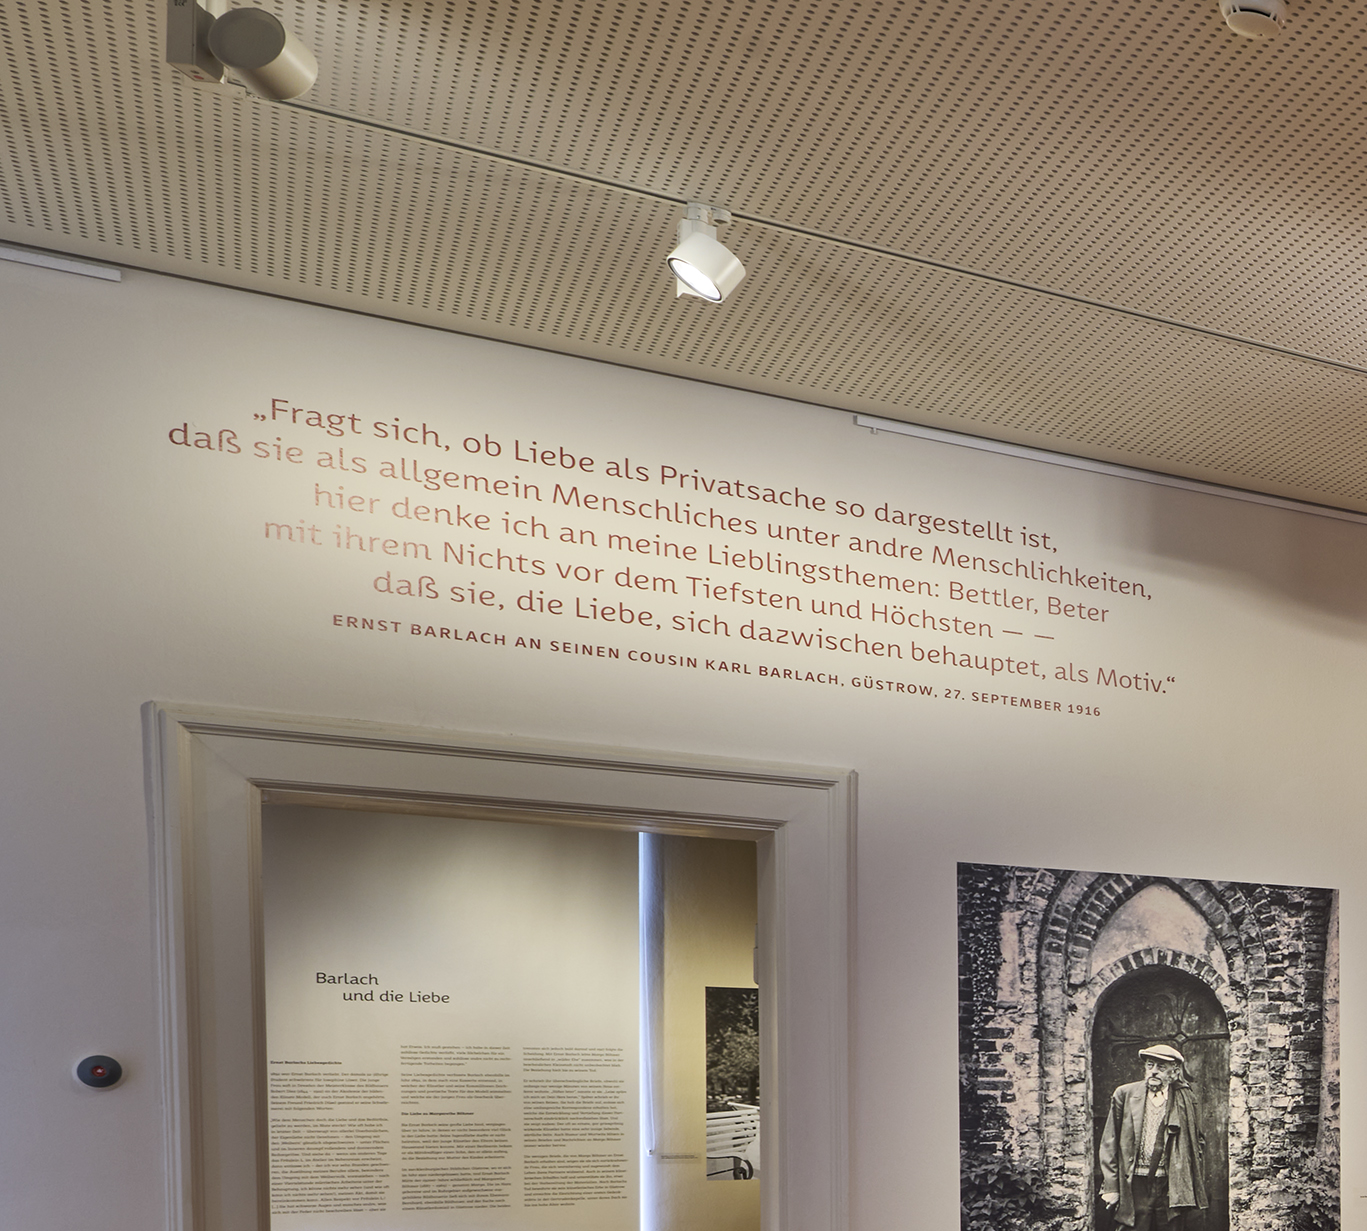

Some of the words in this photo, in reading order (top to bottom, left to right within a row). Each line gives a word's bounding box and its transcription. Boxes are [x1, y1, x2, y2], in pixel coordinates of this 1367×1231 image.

[167, 422, 242, 455] daß
[253, 436, 303, 464] sie
[316, 447, 367, 474] als
[379, 457, 541, 502] allgemein
[552, 483, 758, 535] Menschliches
[767, 523, 840, 548] unter
[848, 536, 923, 561] andre
[931, 545, 1152, 601] Menschlichkeiten,
[373, 421, 451, 452] sich,
[462, 433, 502, 457] ob
[514, 439, 595, 473] Liebe
[605, 457, 649, 482] als
[660, 464, 826, 512] Privatsache
[835, 499, 865, 519] so
[873, 502, 1012, 544] dargestellt
[1020, 525, 1057, 553] ist,
[264, 521, 322, 546] mit
[333, 526, 431, 561] ihrem
[443, 541, 546, 576] Nichts
[555, 562, 604, 583] vor
[614, 566, 677, 595] dem
[686, 575, 802, 612] Tiefsten
[811, 599, 862, 620] und
[871, 603, 993, 639] Höchsten
[314, 482, 380, 514] hier
[391, 496, 491, 531] denke
[501, 511, 549, 540] ich
[559, 527, 597, 547] an
[607, 533, 697, 561] meine
[708, 543, 939, 597] Lieblingsthemen:
[949, 580, 1039, 615] Bettler,
[1047, 595, 1109, 623] Beter
[332, 613, 401, 633] ERNST
[409, 623, 506, 646] BARLACH
[514, 636, 541, 650] AN
[549, 640, 620, 659] SEINEN
[627, 649, 697, 669] COUSIN
[705, 659, 751, 675] KARL
[944, 688, 965, 700] 27.
[971, 691, 1062, 712] SEPTEMBER
[1067, 703, 1101, 717] 1916
[373, 570, 439, 600] daß
[449, 581, 505, 611] sie,
[516, 589, 563, 615] die
[575, 597, 661, 631] Liebe,
[671, 610, 730, 637] sich
[739, 619, 903, 659] dazwischen
[911, 641, 1047, 680] behauptet,
[1054, 662, 1089, 684] als
[316, 972, 378, 985] Barlach
[342, 989, 373, 1002] und
[379, 989, 403, 1002] die
[409, 991, 450, 1004] Liebe
